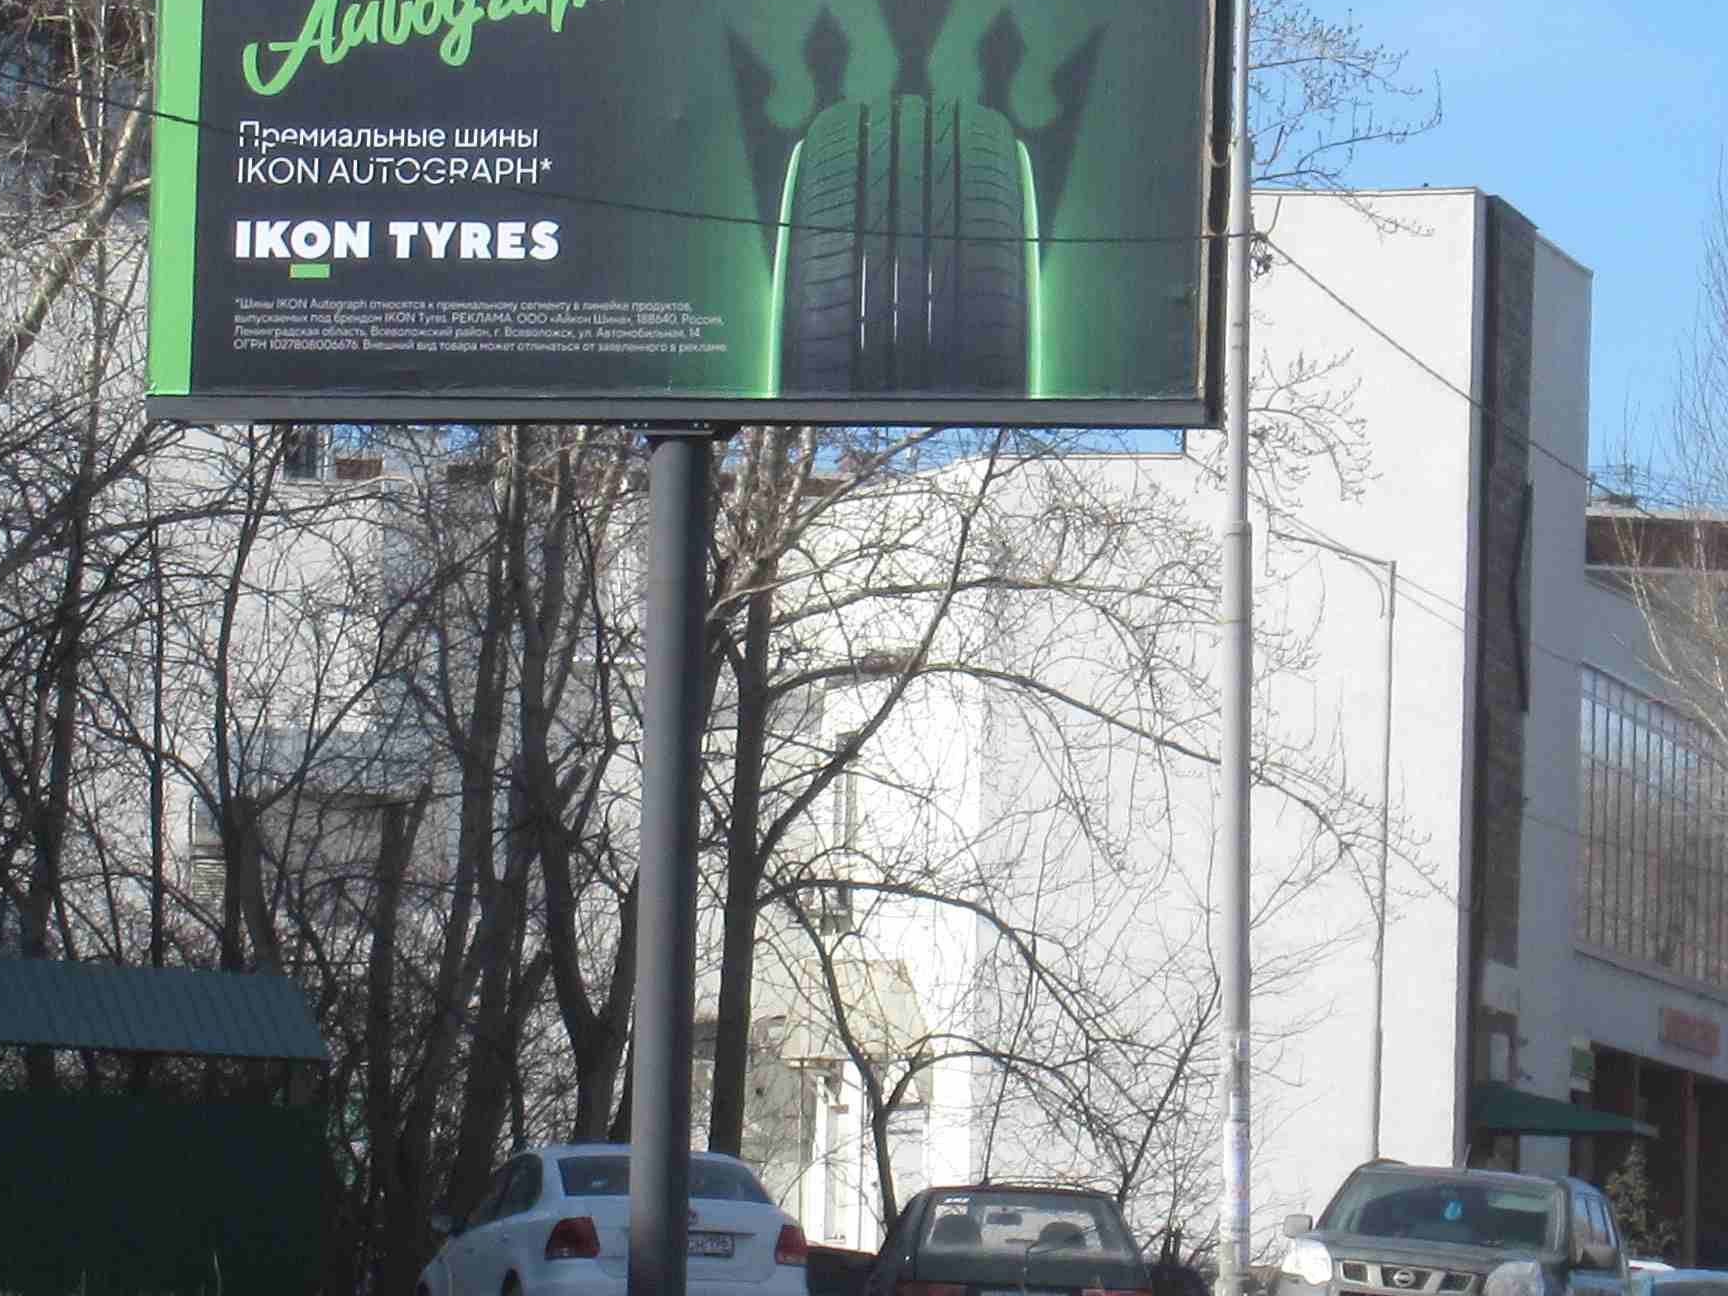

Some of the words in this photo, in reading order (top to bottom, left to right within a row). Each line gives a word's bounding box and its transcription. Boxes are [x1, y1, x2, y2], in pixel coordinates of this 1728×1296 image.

[239, 120, 446, 154] Премиальные
[454, 128, 539, 148] шины
[237, 157, 320, 184] IKON
[235, 220, 370, 259] IKON
[389, 220, 560, 260] TYRES
[276, 298, 307, 310] IKON
[309, 298, 368, 313] Autograph
[384, 312, 415, 324] IKON
